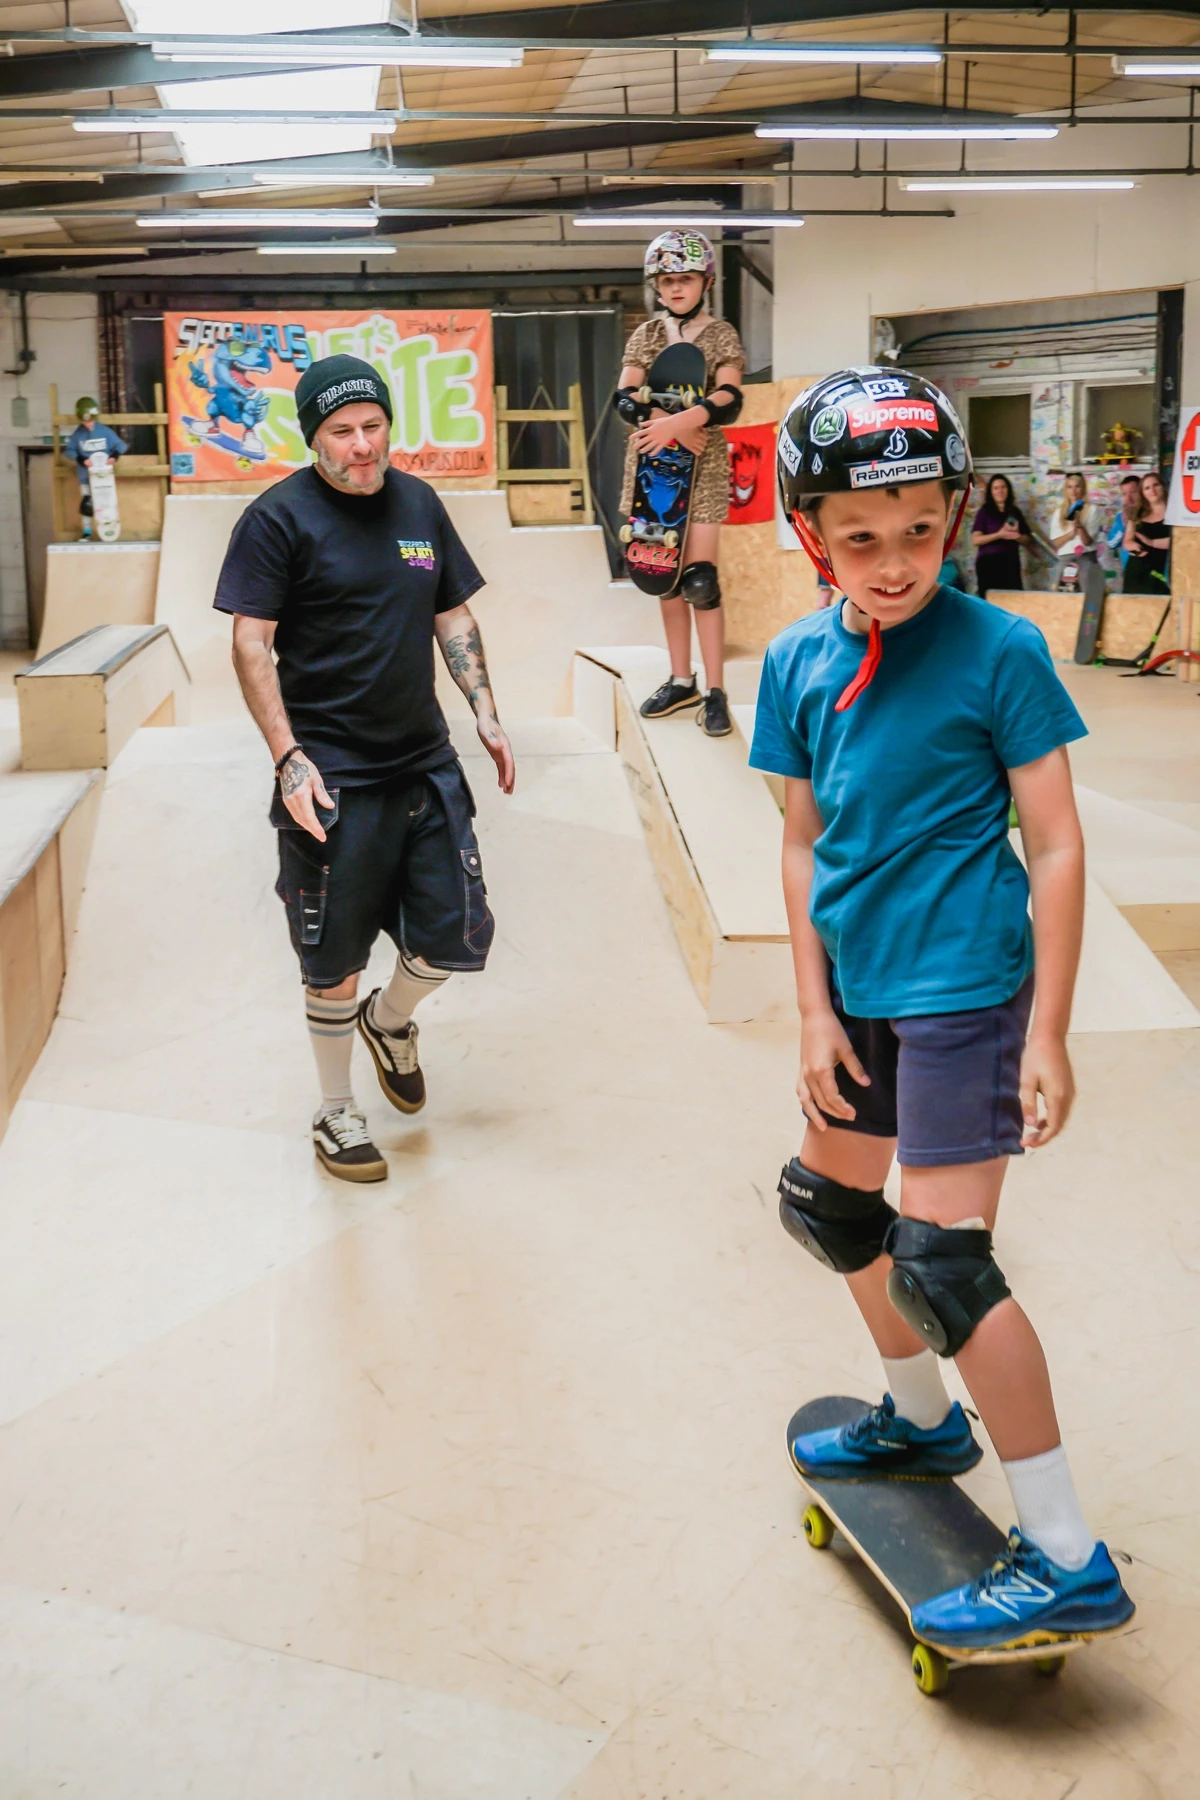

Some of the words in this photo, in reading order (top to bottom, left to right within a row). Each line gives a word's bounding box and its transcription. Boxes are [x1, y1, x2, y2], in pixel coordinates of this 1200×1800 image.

[851, 406, 935, 429] Supreme
[627, 542, 679, 568] ZERO
[790, 1183, 814, 1200] GEAR
